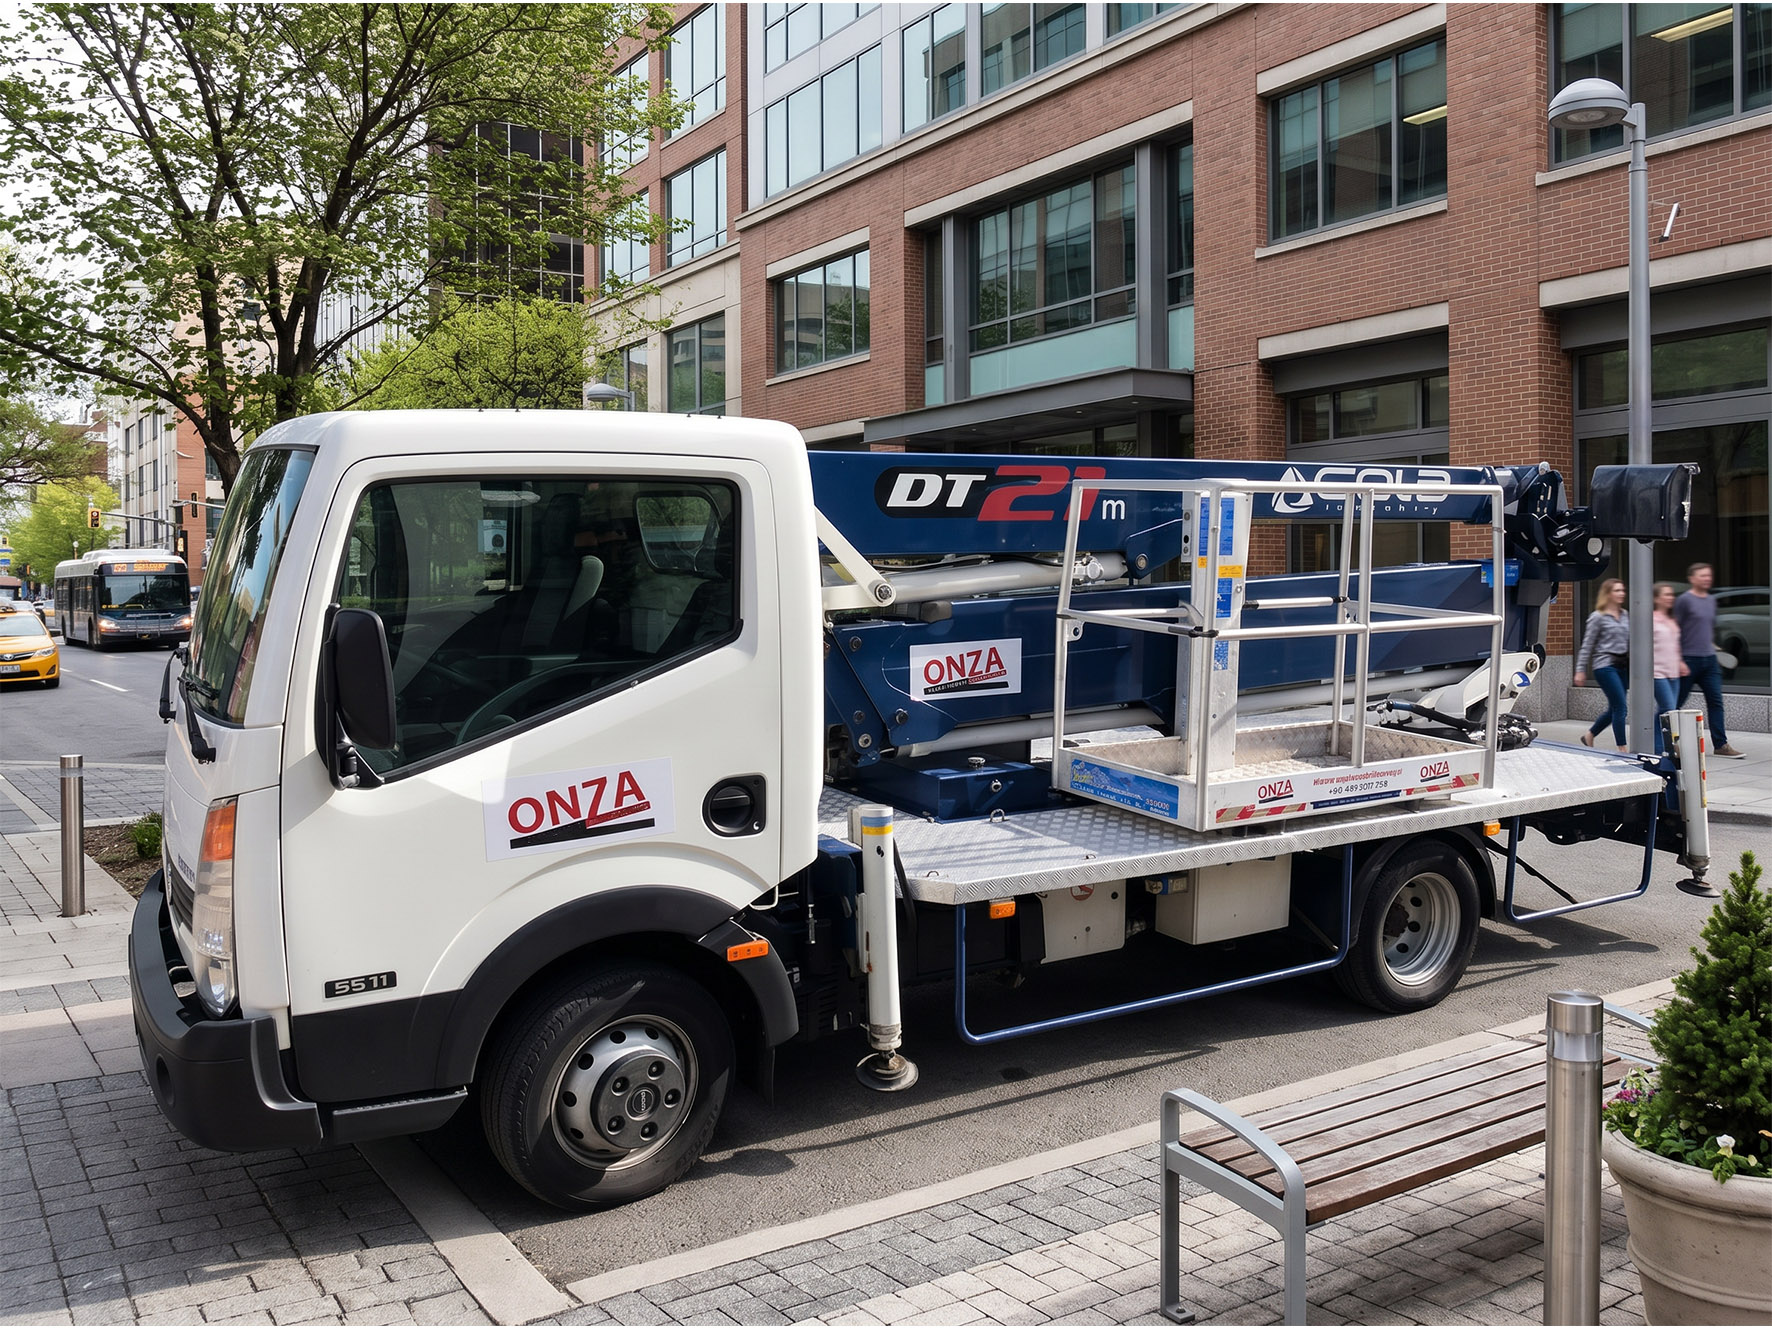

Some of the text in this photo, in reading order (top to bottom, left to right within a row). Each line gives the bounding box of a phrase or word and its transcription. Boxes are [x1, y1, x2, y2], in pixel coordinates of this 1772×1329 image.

[1102, 499, 1126, 520] m
[923, 646, 1005, 685] ONZA
[1419, 761, 1450, 778] ONZA
[1257, 779, 1294, 799] ONZA
[1328, 786, 1343, 795] +90
[507, 770, 647, 834] ONZA
